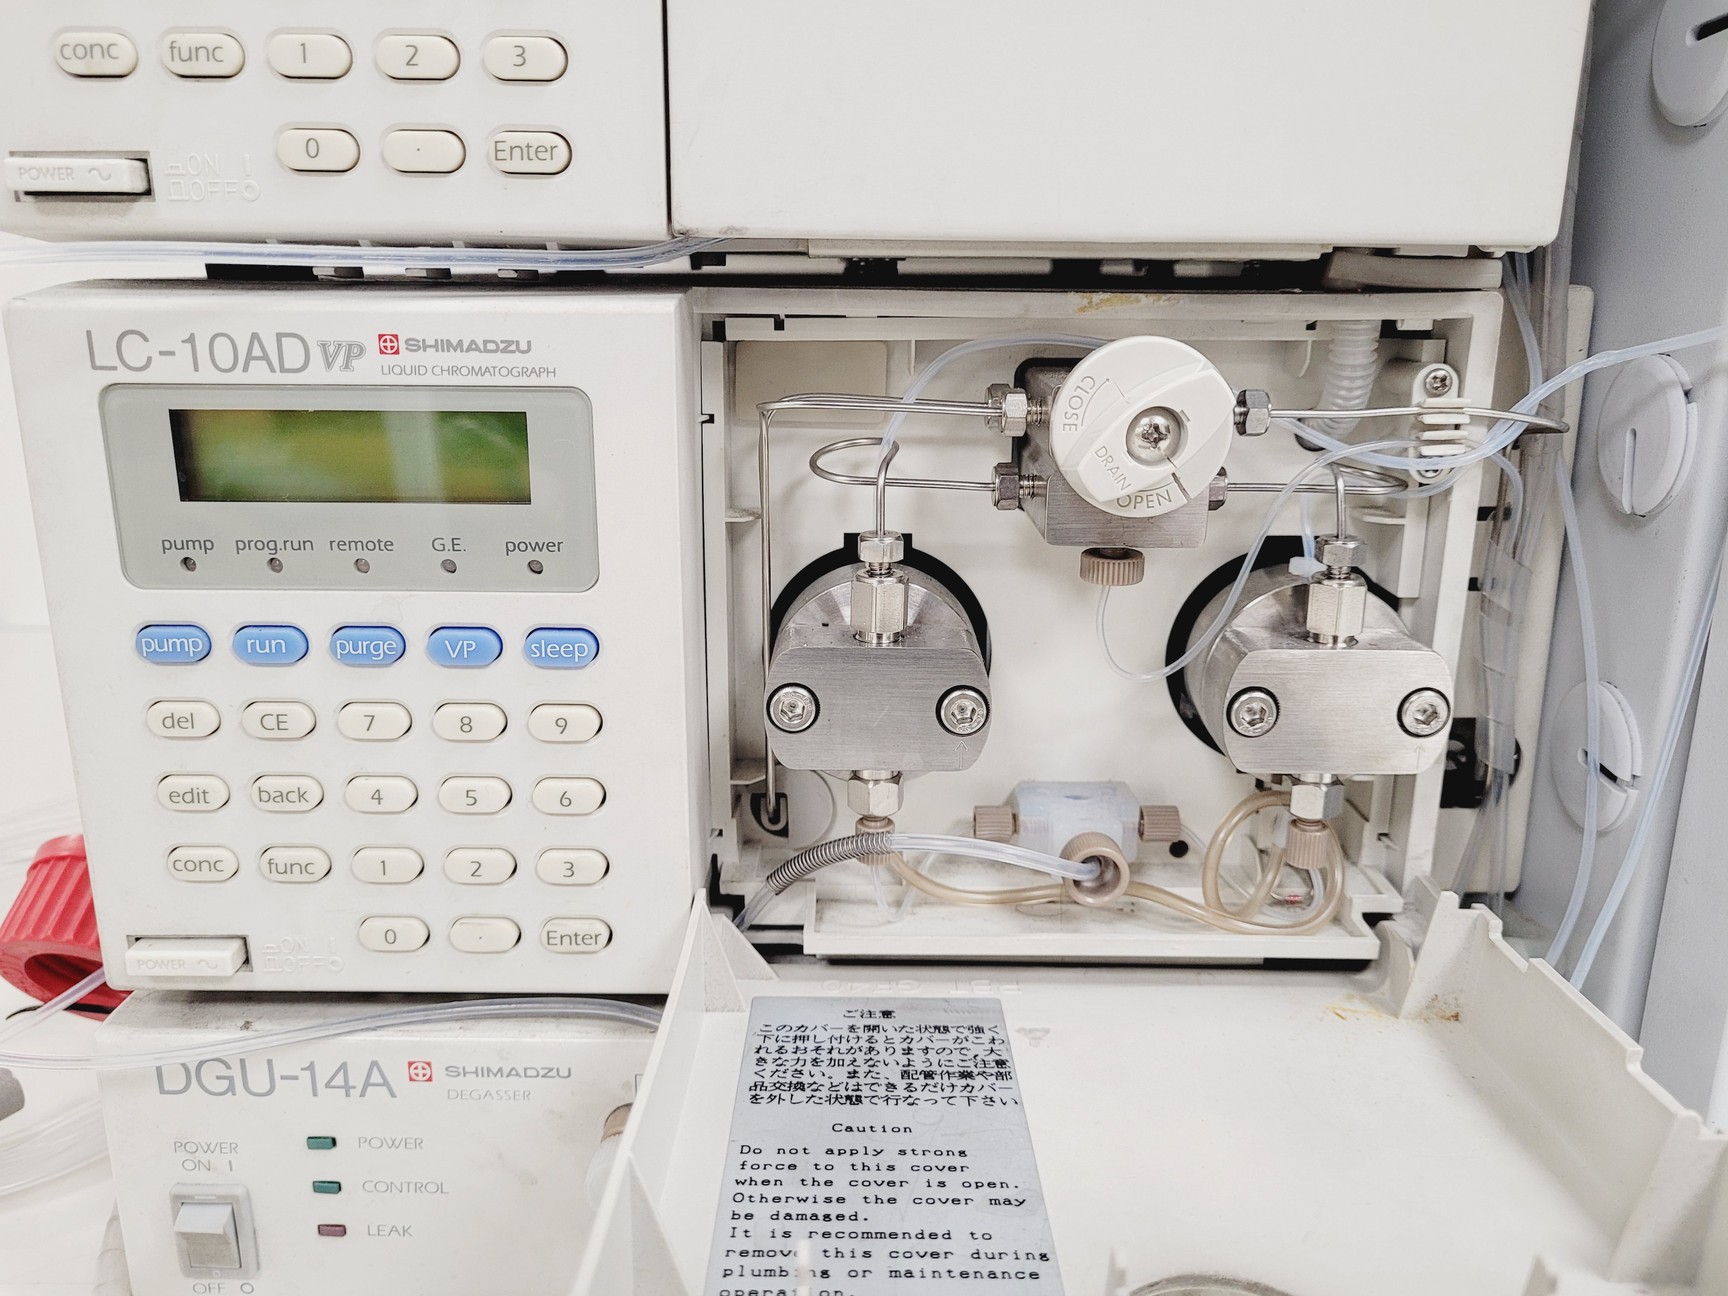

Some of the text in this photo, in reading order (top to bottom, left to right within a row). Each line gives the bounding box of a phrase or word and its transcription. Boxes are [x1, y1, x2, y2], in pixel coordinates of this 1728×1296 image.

[59, 43, 119, 61] conc
[168, 40, 224, 63] func
[300, 42, 307, 64] 1
[405, 44, 419, 67] 2
[513, 45, 527, 67] 3
[305, 137, 320, 159] 0
[494, 140, 559, 162] Enter
[188, 153, 220, 176] ON
[18, 167, 74, 181] POWER
[189, 179, 237, 201] OFF
[85, 329, 367, 374] LC-10AD VP
[404, 337, 532, 355] SHIMADZU
[381, 364, 556, 378] LIQUID CHROMATOGRAPH
[1062, 375, 1096, 432] CLOSE
[1094, 447, 1131, 491] DRAIN
[1116, 489, 1172, 509] OPEN
[161, 539, 215, 555] pump
[235, 539, 314, 556] prog.run
[329, 538, 394, 552] remote
[431, 537, 467, 552] G.E.
[505, 541, 564, 557] power
[141, 637, 203, 657] pump
[246, 639, 286, 654] run
[336, 640, 397, 660] purge
[444, 640, 476, 659] VP
[530, 639, 589, 662] sleep
[162, 712, 195, 730] del
[260, 713, 289, 731] CE
[363, 714, 376, 732] 7
[459, 715, 473, 734] 8
[555, 717, 568, 735] 9
[168, 787, 210, 804] edit
[258, 786, 309, 804] back
[370, 788, 384, 806] 4
[465, 789, 478, 807] 5
[559, 790, 572, 808] 6
[172, 859, 225, 873] conc
[267, 858, 315, 875] func
[380, 860, 386, 876] 1
[470, 860, 482, 877] 2
[563, 861, 575, 878] 3
[384, 928, 397, 945] 0
[546, 930, 602, 946] Enter
[138, 959, 186, 969] POWER
[842, 1008, 897, 1019] ご注意
[154, 1060, 399, 1098] DGU-14A
[444, 1065, 572, 1079] SHIMADZU
[447, 1089, 531, 1101] DEGASSER
[831, 1123, 912, 1133] Caution
[173, 1140, 239, 1155] POWER
[358, 1136, 424, 1150] POWER
[739, 1144, 968, 1158] Do not apply strong
[181, 1158, 211, 1172] ON
[740, 1160, 969, 1173] force to this cover
[362, 1180, 449, 1195] CONTROL
[734, 1176, 1019, 1190] when the cover is open.
[732, 1192, 1026, 1207] Otherwise the cover may
[730, 1209, 868, 1223] be damaged.
[367, 1224, 413, 1237] LEAK
[729, 1226, 993, 1241] It is recommended to
[822, 1247, 873, 1259] this
[888, 1250, 954, 1259] cover
[970, 1248, 1050, 1262] during
[721, 1265, 1040, 1280] plumbng or maintenance
[192, 1282, 222, 1294] OFF
